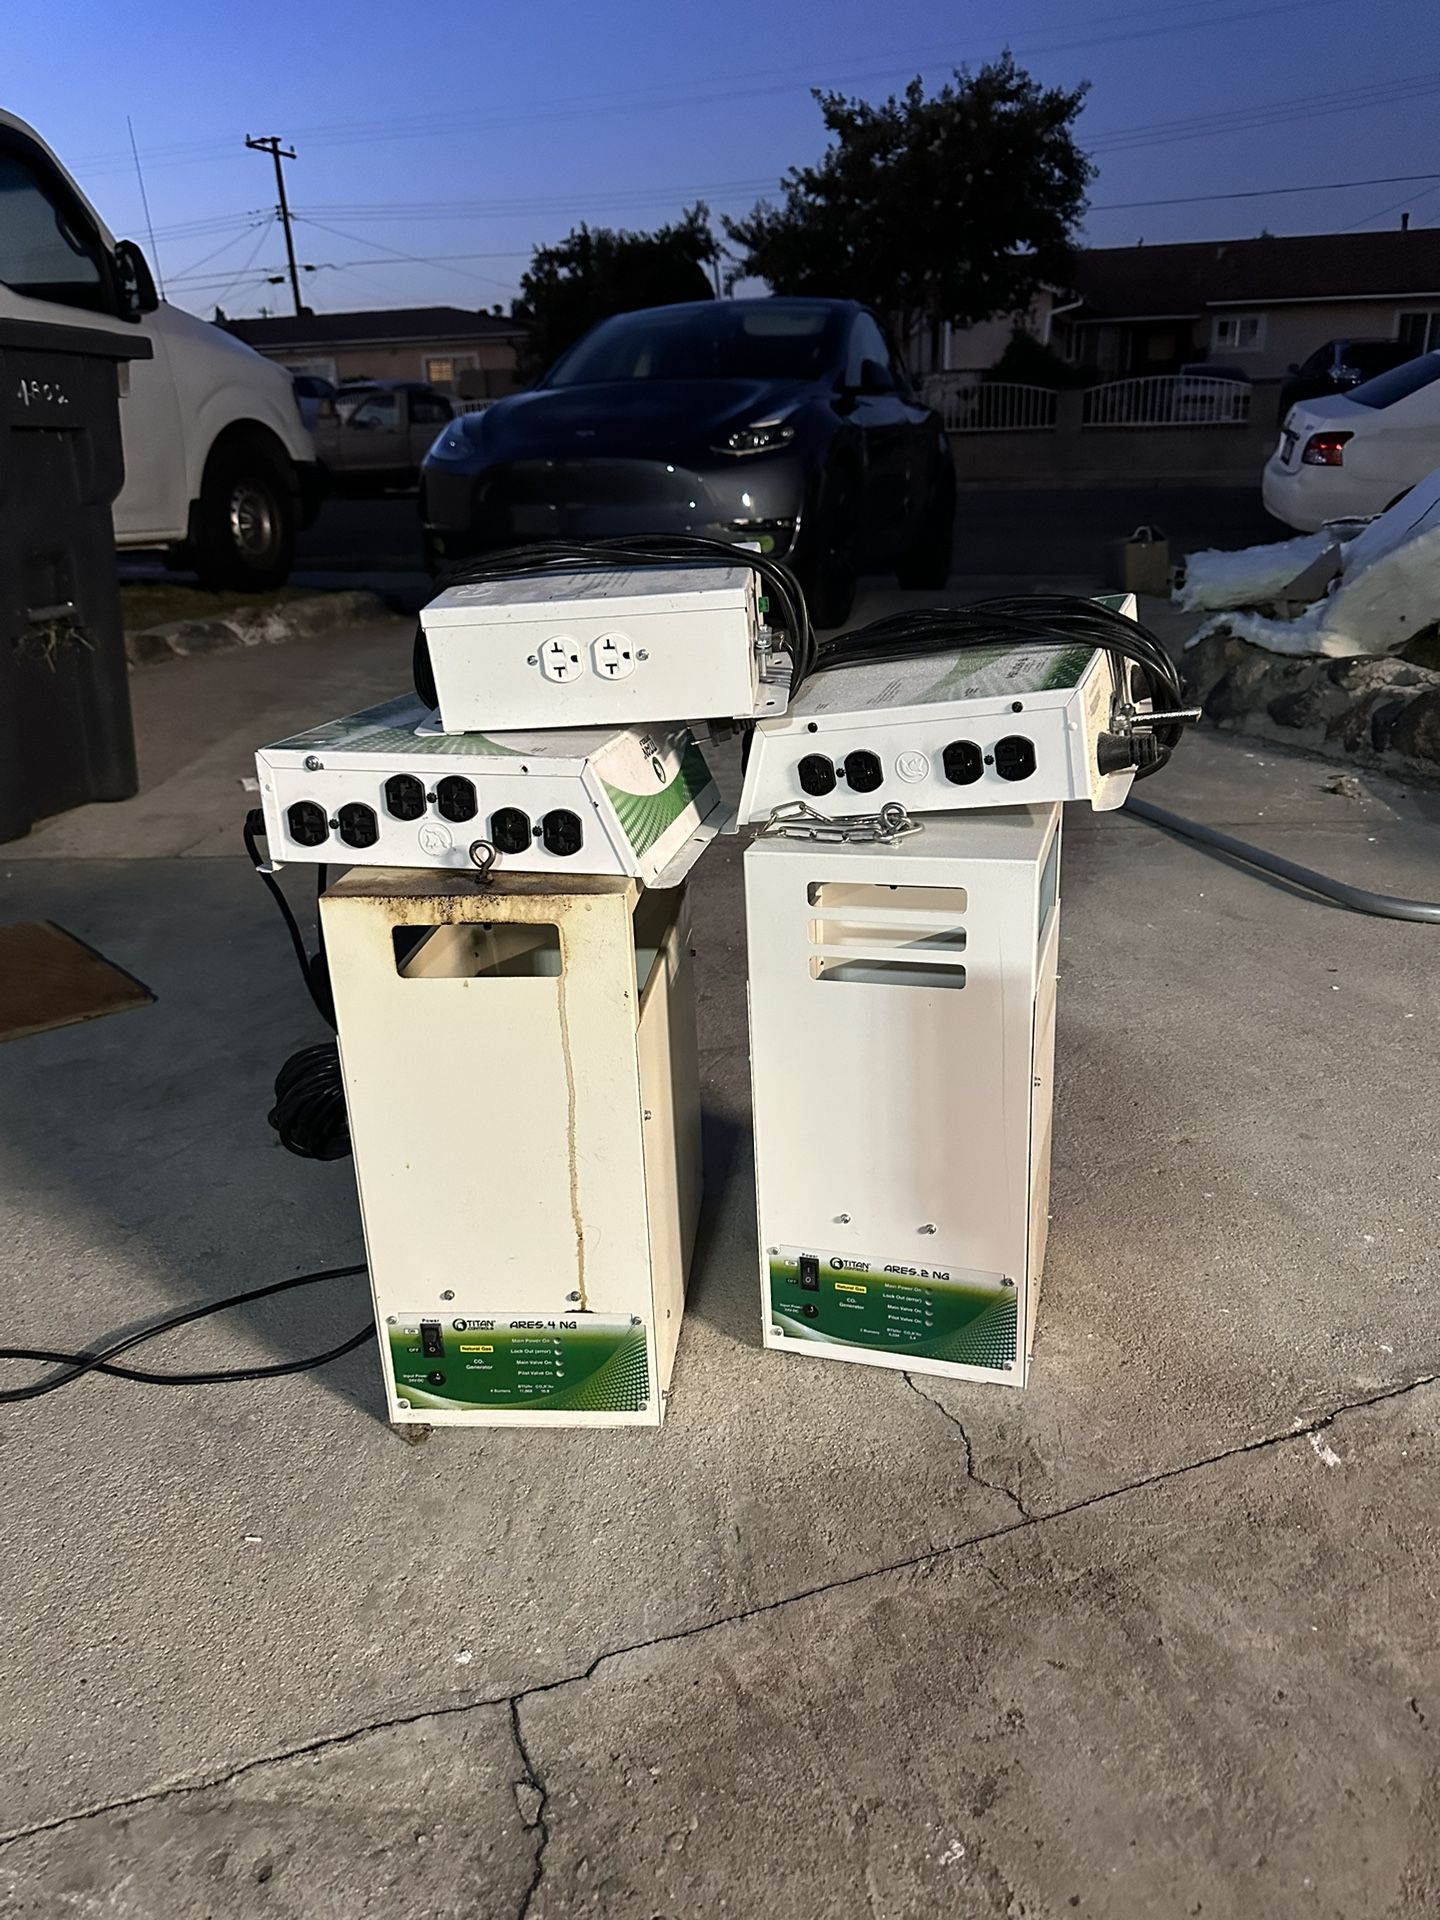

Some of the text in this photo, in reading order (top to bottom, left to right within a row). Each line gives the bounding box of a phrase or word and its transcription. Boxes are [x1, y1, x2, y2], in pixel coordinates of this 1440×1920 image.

[844, 1260, 869, 1269] TITAN
[884, 1264, 950, 1281] ARES.2 NG
[466, 1319, 494, 1328] TITAN
[509, 1320, 577, 1330] ARES.4 NG
